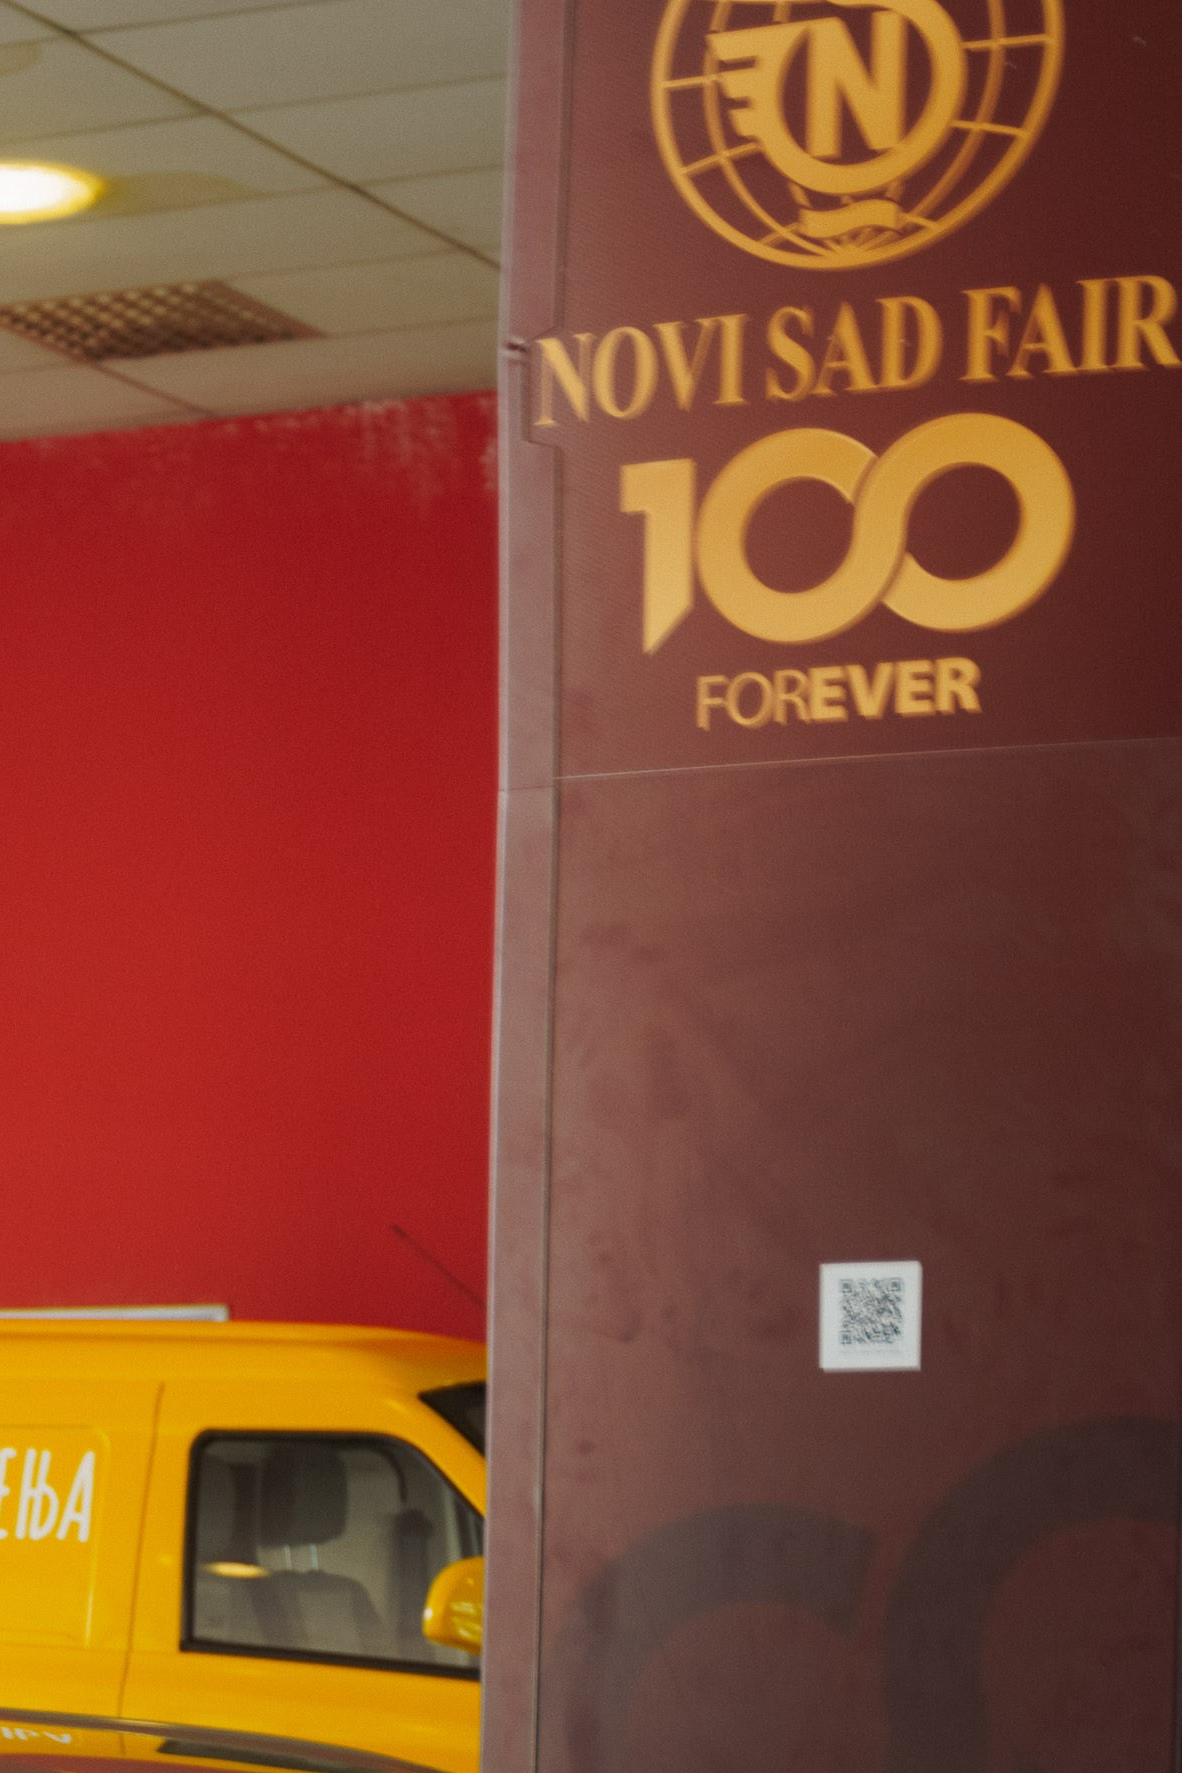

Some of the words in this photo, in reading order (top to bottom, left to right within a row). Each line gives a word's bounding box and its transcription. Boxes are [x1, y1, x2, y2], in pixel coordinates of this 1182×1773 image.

[532, 313, 749, 427] NOVI
[766, 296, 942, 402] SAD
[961, 274, 1182, 384] FAIR
[621, 412, 1076, 656] 100
[696, 656, 982, 731] FOREVER
